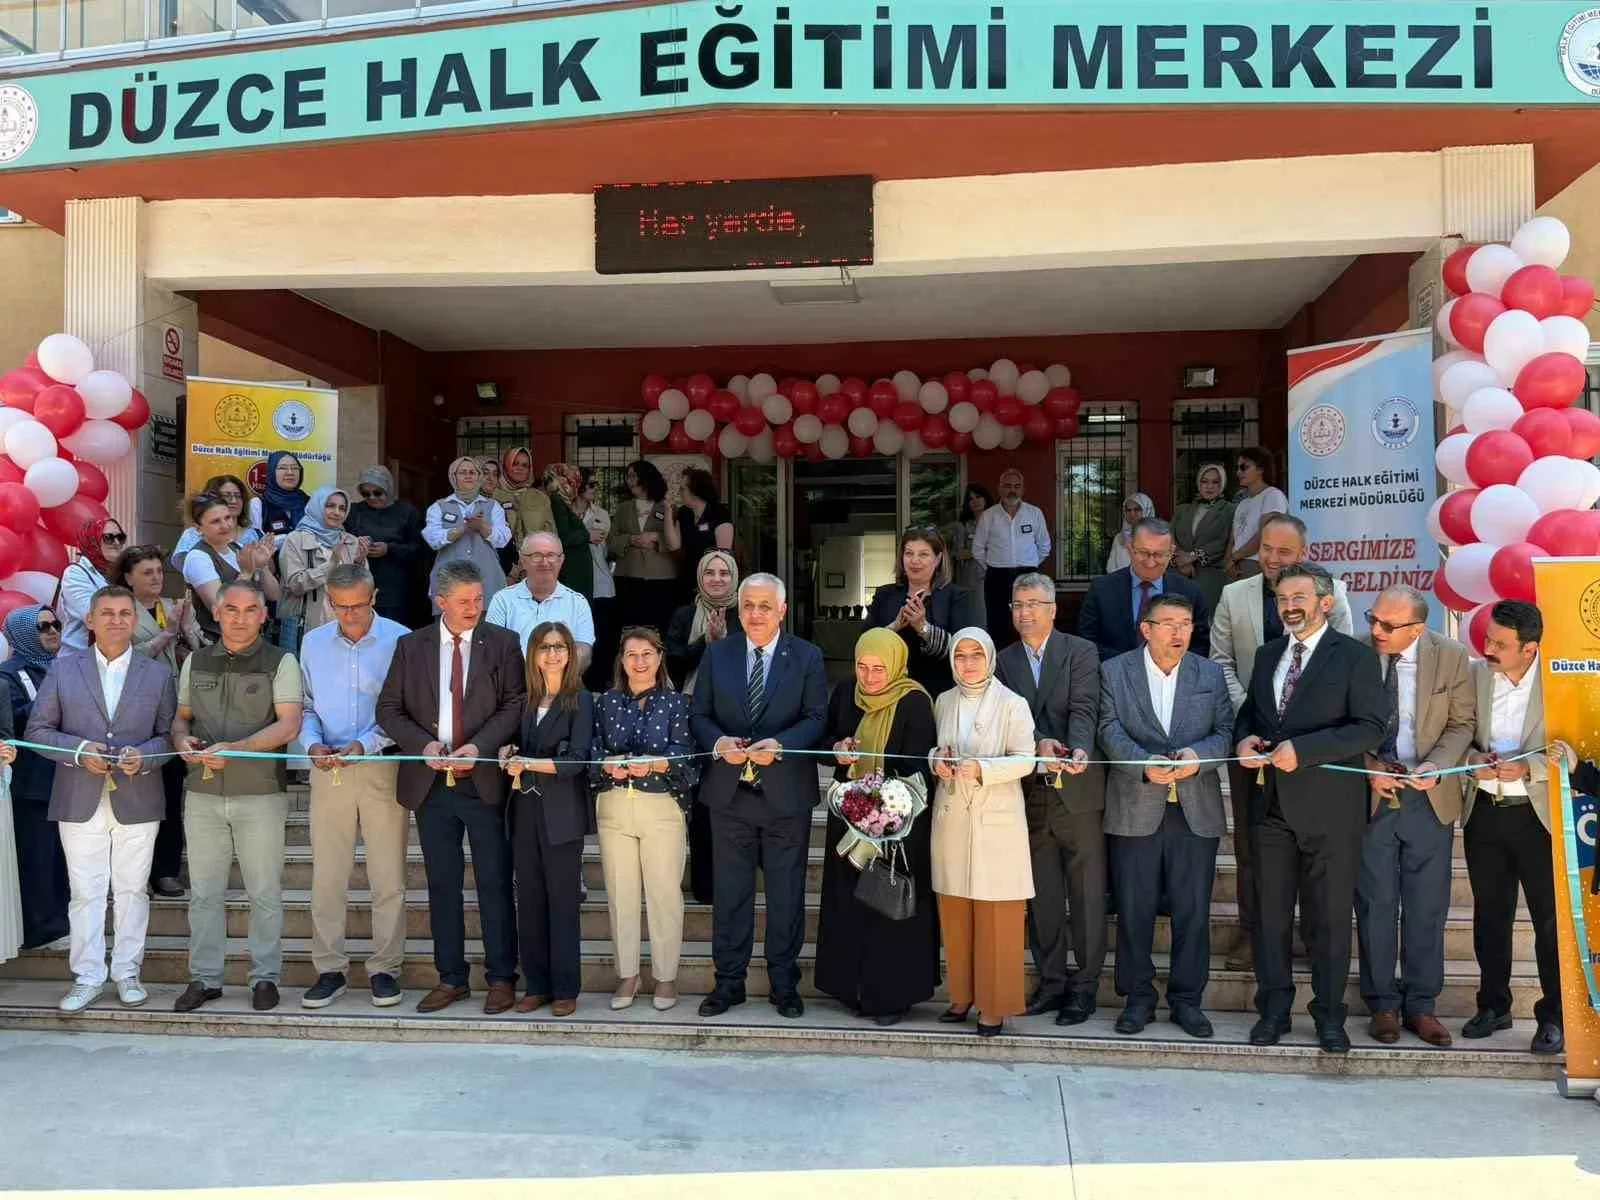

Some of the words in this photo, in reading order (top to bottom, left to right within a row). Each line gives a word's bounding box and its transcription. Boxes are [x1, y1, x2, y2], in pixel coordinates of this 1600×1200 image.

[69, 66, 327, 151] DÜZCE
[366, 37, 601, 122] HALK
[640, 5, 1007, 96] EĞİTİMİ
[1052, 7, 1493, 90] MERKEZİ
[1304, 475, 1339, 490] DÜZCE
[1342, 474, 1372, 488] HALK
[1375, 467, 1419, 485] EĞİTİMİ
[1300, 493, 1347, 510] MERKEZİ
[1350, 488, 1425, 507] MÜDÜRLÜĞÜ
[1309, 533, 1416, 561] SERGİMİZE
[1552, 660, 1585, 671] Düzce
